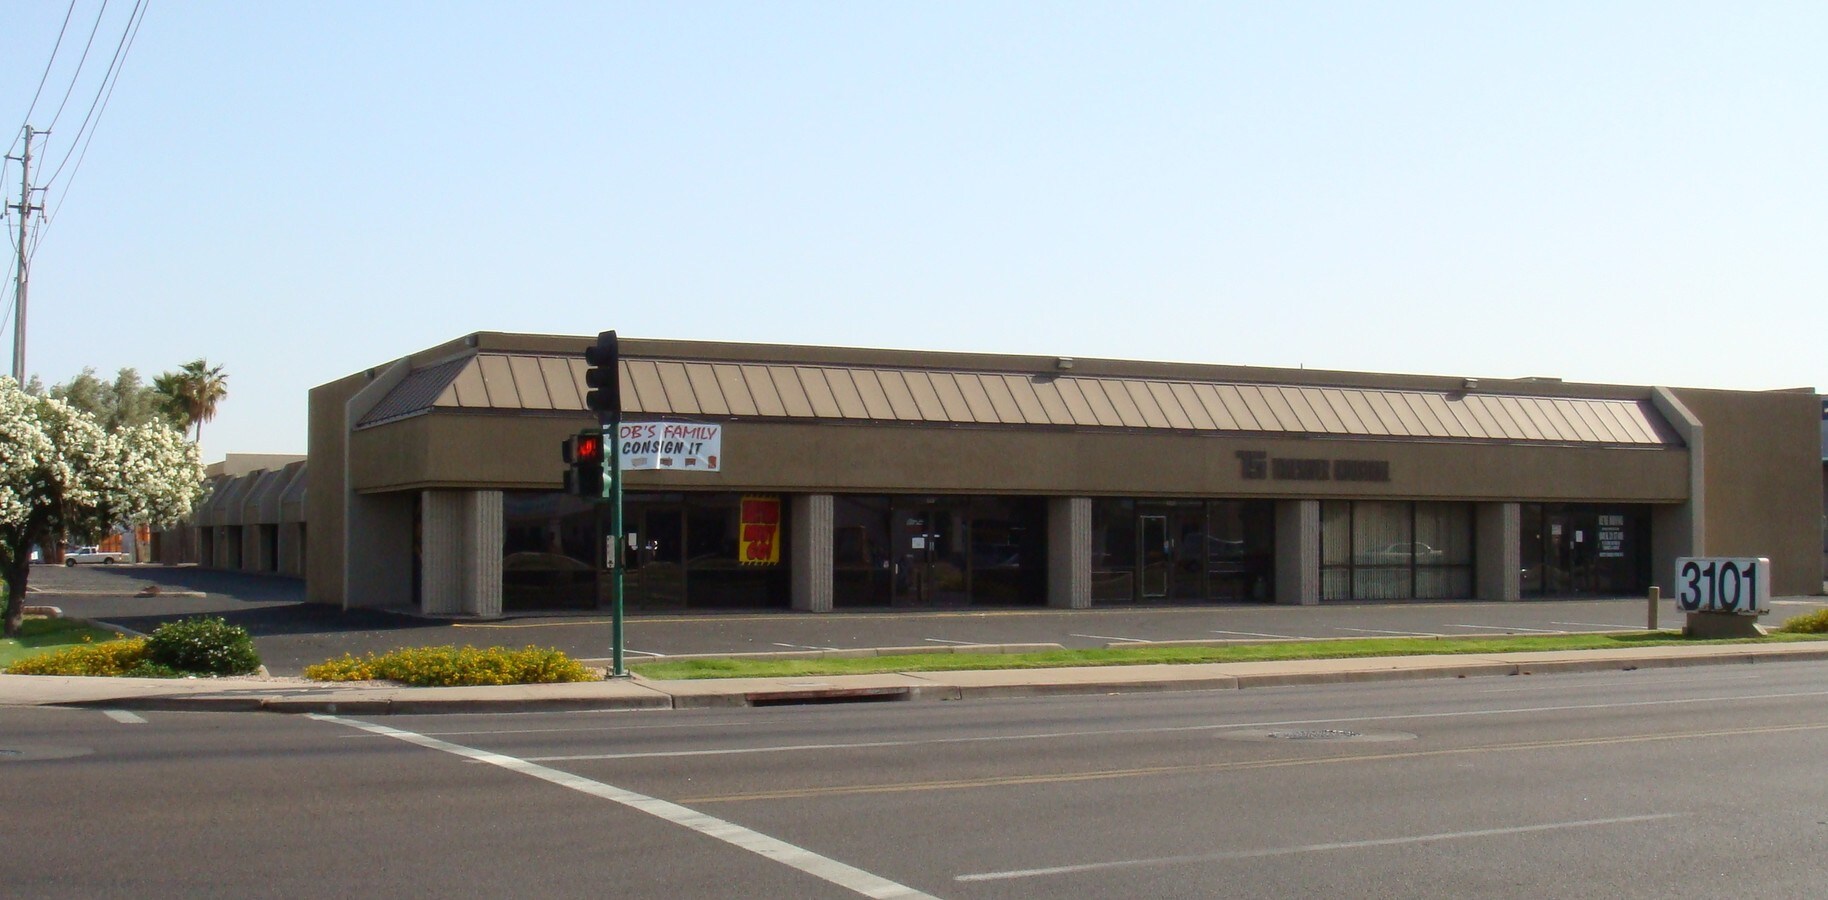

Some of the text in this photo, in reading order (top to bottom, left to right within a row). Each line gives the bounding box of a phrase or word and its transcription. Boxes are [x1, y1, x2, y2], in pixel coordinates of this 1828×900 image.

[664, 425, 717, 440] FAMILY
[622, 440, 703, 455] CONSIGN IT
[1681, 561, 1756, 612] 3101
